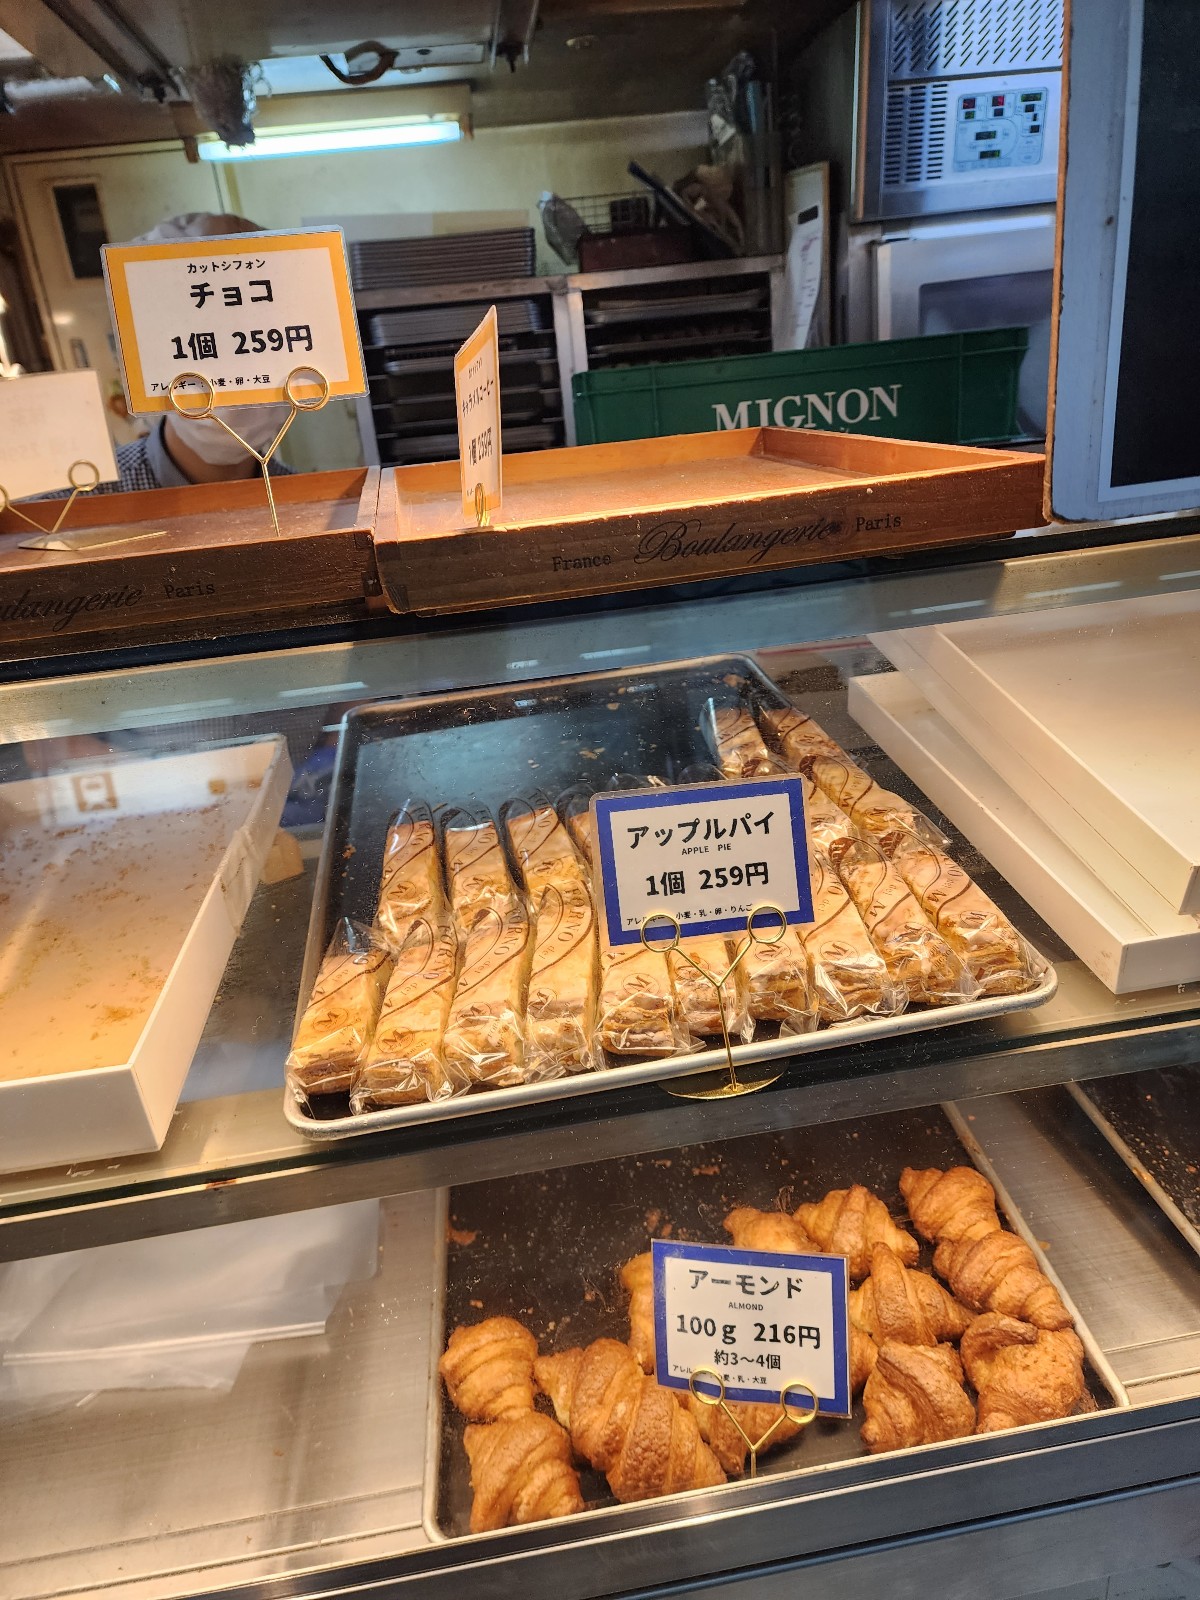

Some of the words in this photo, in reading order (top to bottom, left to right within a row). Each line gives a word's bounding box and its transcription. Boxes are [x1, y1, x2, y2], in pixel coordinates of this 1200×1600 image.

[186, 258, 266, 274] カットシフォン
[189, 279, 274, 309] チョコ
[171, 331, 219, 361] 1個
[231, 324, 313, 355] 259円
[711, 384, 903, 431] MIGNON
[551, 554, 613, 572] France
[633, 518, 834, 564] Boulangerie
[856, 513, 902, 532] Paris
[163, 582, 216, 599] Paris
[626, 811, 775, 850] アップルパイ
[681, 845, 710, 856] APPLE
[717, 843, 732, 852] PIE
[645, 870, 686, 897] 1個
[698, 861, 770, 890] 259円
[558, 886, 586, 942] FORNO
[688, 1268, 803, 1299] アーモンド
[728, 1301, 764, 1311] ALMOND
[753, 1322, 821, 1350] 216円
